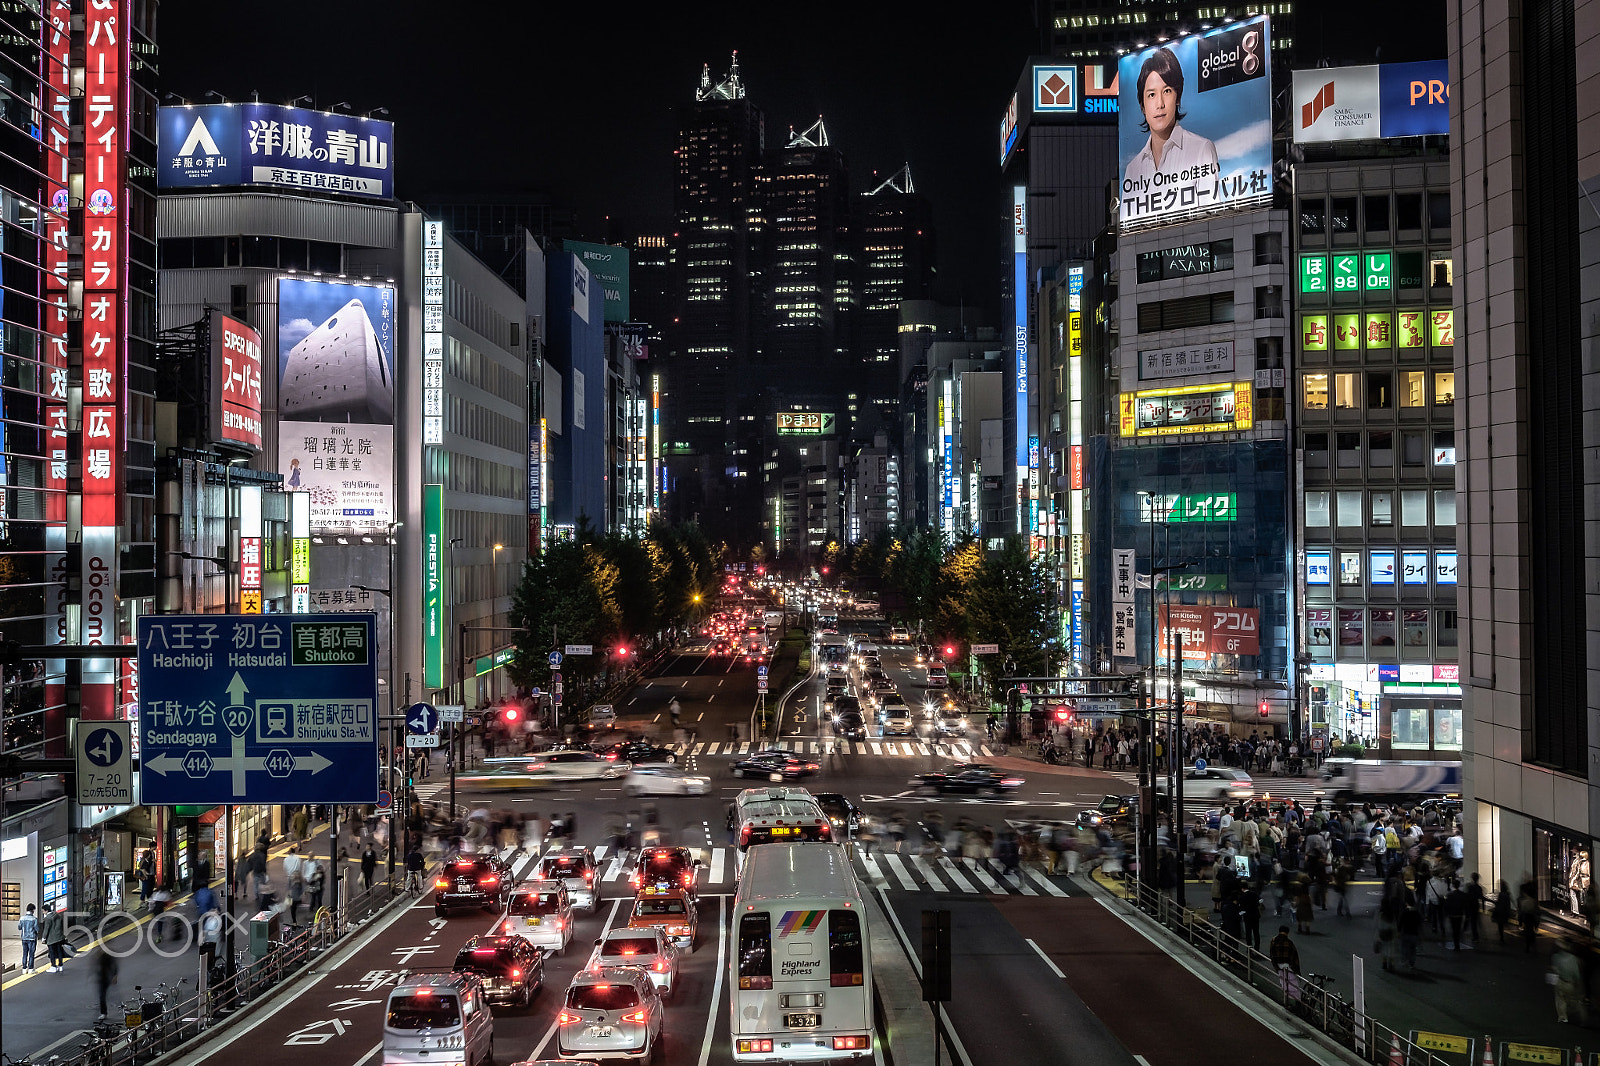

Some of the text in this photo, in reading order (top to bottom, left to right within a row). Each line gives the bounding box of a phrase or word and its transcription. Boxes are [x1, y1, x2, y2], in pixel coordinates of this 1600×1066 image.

[1202, 45, 1240, 78] global
[1411, 79, 1450, 106] PR
[1085, 99, 1119, 112] SHIN
[1334, 113, 1372, 121] CONSUMER
[248, 120, 388, 170] 洋服の青山
[172, 156, 227, 168] 洋服の青山
[271, 169, 367, 190] 京王百貨店向い
[1123, 163, 1220, 193] Only One の住まい
[1123, 170, 1267, 217] THEグローバル社
[1306, 256, 1385, 275] ほぐし
[88, 226, 113, 479] カラオケ歌広場
[1148, 346, 1228, 368] 新宿矯正歯科
[781, 414, 818, 426] やまや
[304, 437, 372, 455] 瑠璃光院
[530, 440, 539, 465] JAPAN
[313, 457, 362, 471] 白蓮華堂
[530, 466, 539, 488] TOTAL
[530, 489, 539, 510] CLUB
[1186, 497, 1229, 516] レイク
[1118, 554, 1130, 597] 工事中
[1179, 575, 1206, 588] レイク
[294, 586, 307, 594] KM
[1126, 606, 1134, 628] 全館
[1213, 612, 1256, 631] アコム
[146, 622, 364, 649] 八王子 初台 首都高
[1115, 611, 1126, 653] 営業中
[1162, 626, 1205, 647] 営業中
[1227, 639, 1240, 651] 6F
[153, 653, 287, 670] Hachioji Hatsudai
[305, 650, 355, 662] Shutoko
[228, 711, 247, 727] 20
[297, 704, 369, 724] 新宿駅西口
[147, 730, 217, 747] Sendagaya
[297, 727, 337, 740] Shinjuku
[187, 758, 208, 771] 414
[269, 757, 291, 771] 414
[82, 787, 128, 799] この先50m
[781, 960, 820, 971] Highland
[781, 968, 812, 977] Express
